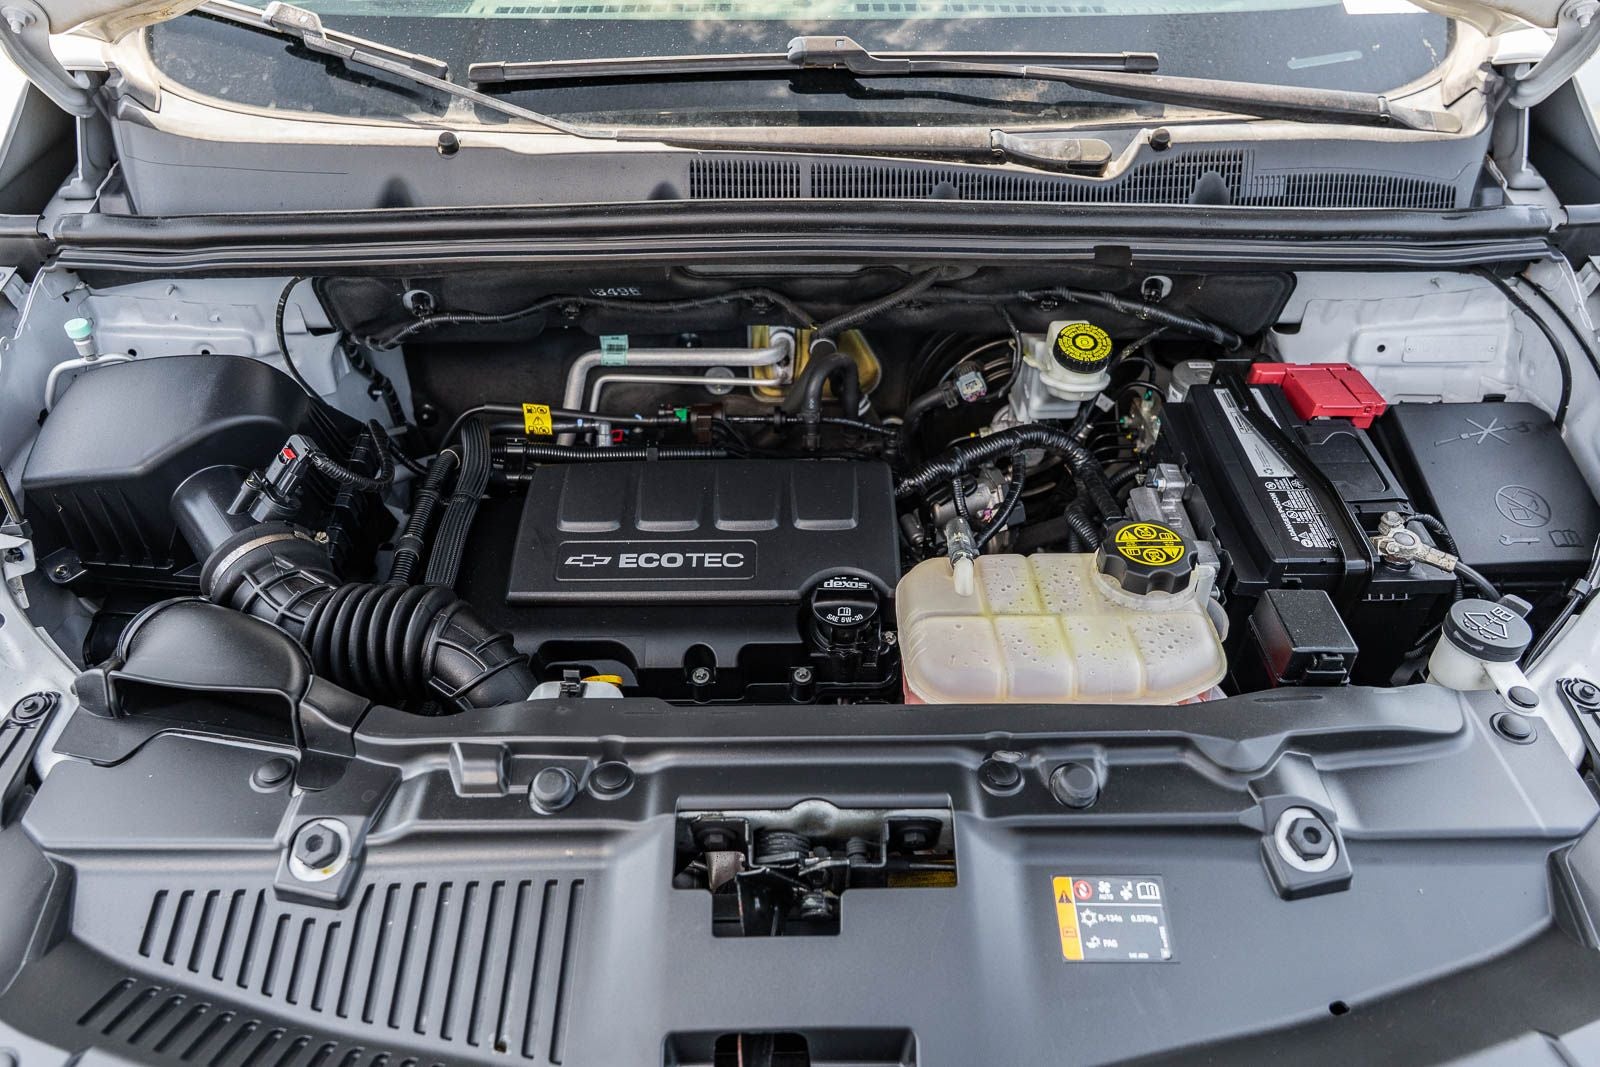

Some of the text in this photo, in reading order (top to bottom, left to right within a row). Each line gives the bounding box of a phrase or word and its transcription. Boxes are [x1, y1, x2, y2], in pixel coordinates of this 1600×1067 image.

[618, 552, 744, 568] ECOTEC
[823, 579, 868, 589] dexos
[826, 613, 863, 623] SAE 5W-30
